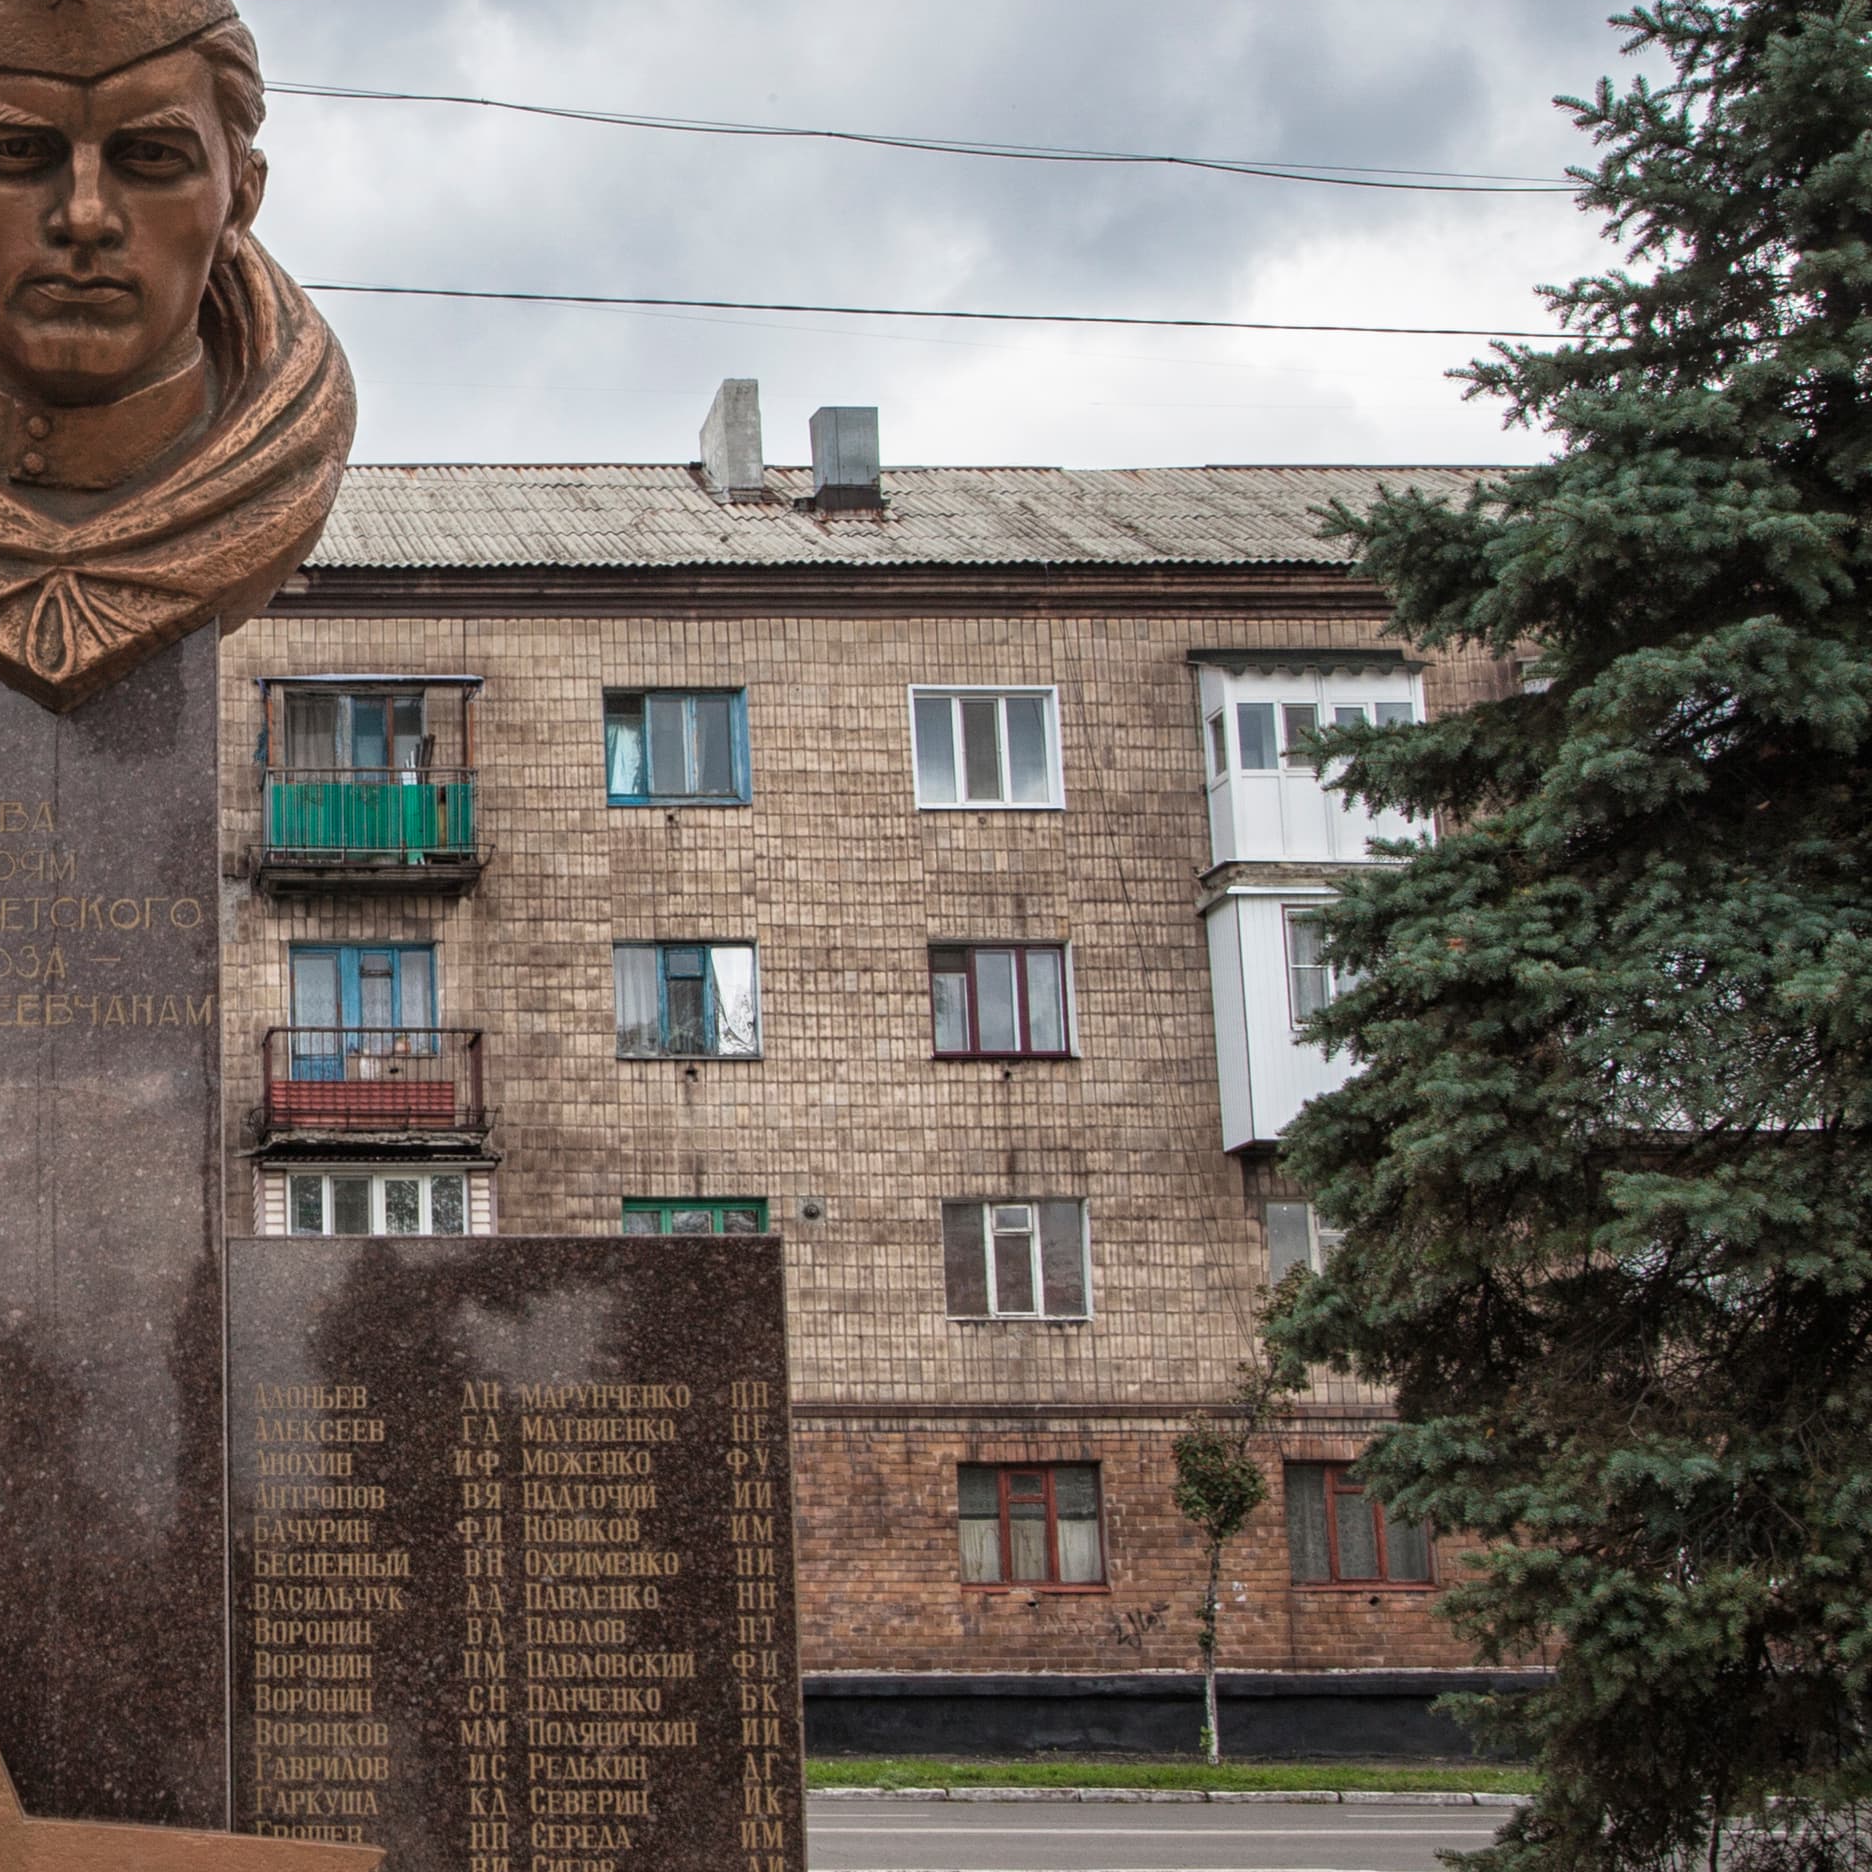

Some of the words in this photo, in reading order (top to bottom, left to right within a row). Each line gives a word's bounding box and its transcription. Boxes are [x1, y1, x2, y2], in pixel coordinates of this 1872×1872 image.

[520, 1384, 692, 1409] МАРУНЧЕНКО
[254, 1416, 385, 1442] АЛЕКСЕЕВ
[522, 1416, 675, 1442] МАТВИЕНКО
[522, 1448, 651, 1476] МОЖЕНКО
[255, 1483, 385, 1510] АНТРОПОВ
[255, 1516, 370, 1543] БАЧУРИН
[524, 1516, 640, 1543] НОВИКОВ
[525, 1550, 680, 1576] ОХРИМЕНКО
[255, 1584, 404, 1610] ВАСИЛЬЧУК
[525, 1584, 659, 1610] ПАВЛЕНКО
[255, 1618, 372, 1644] ВОРОНИН
[526, 1616, 626, 1644] ПАВЛОВ
[255, 1652, 372, 1678] ВОРОНИН
[255, 1685, 372, 1712] ВОРОНИН
[528, 1685, 661, 1712] ПАНЧЕНКО
[255, 1719, 388, 1746] ВОРОНКОВ
[528, 1718, 698, 1746] ПОЛЯНИЧКИН
[255, 1752, 389, 1781] ГАВРИЛОВ
[528, 1752, 648, 1782] РЕДЬКИН
[255, 1786, 379, 1815] ГАРКУША
[530, 1786, 650, 1815] СЕВЕРИН
[532, 1822, 631, 1850] СЕРЕДА
